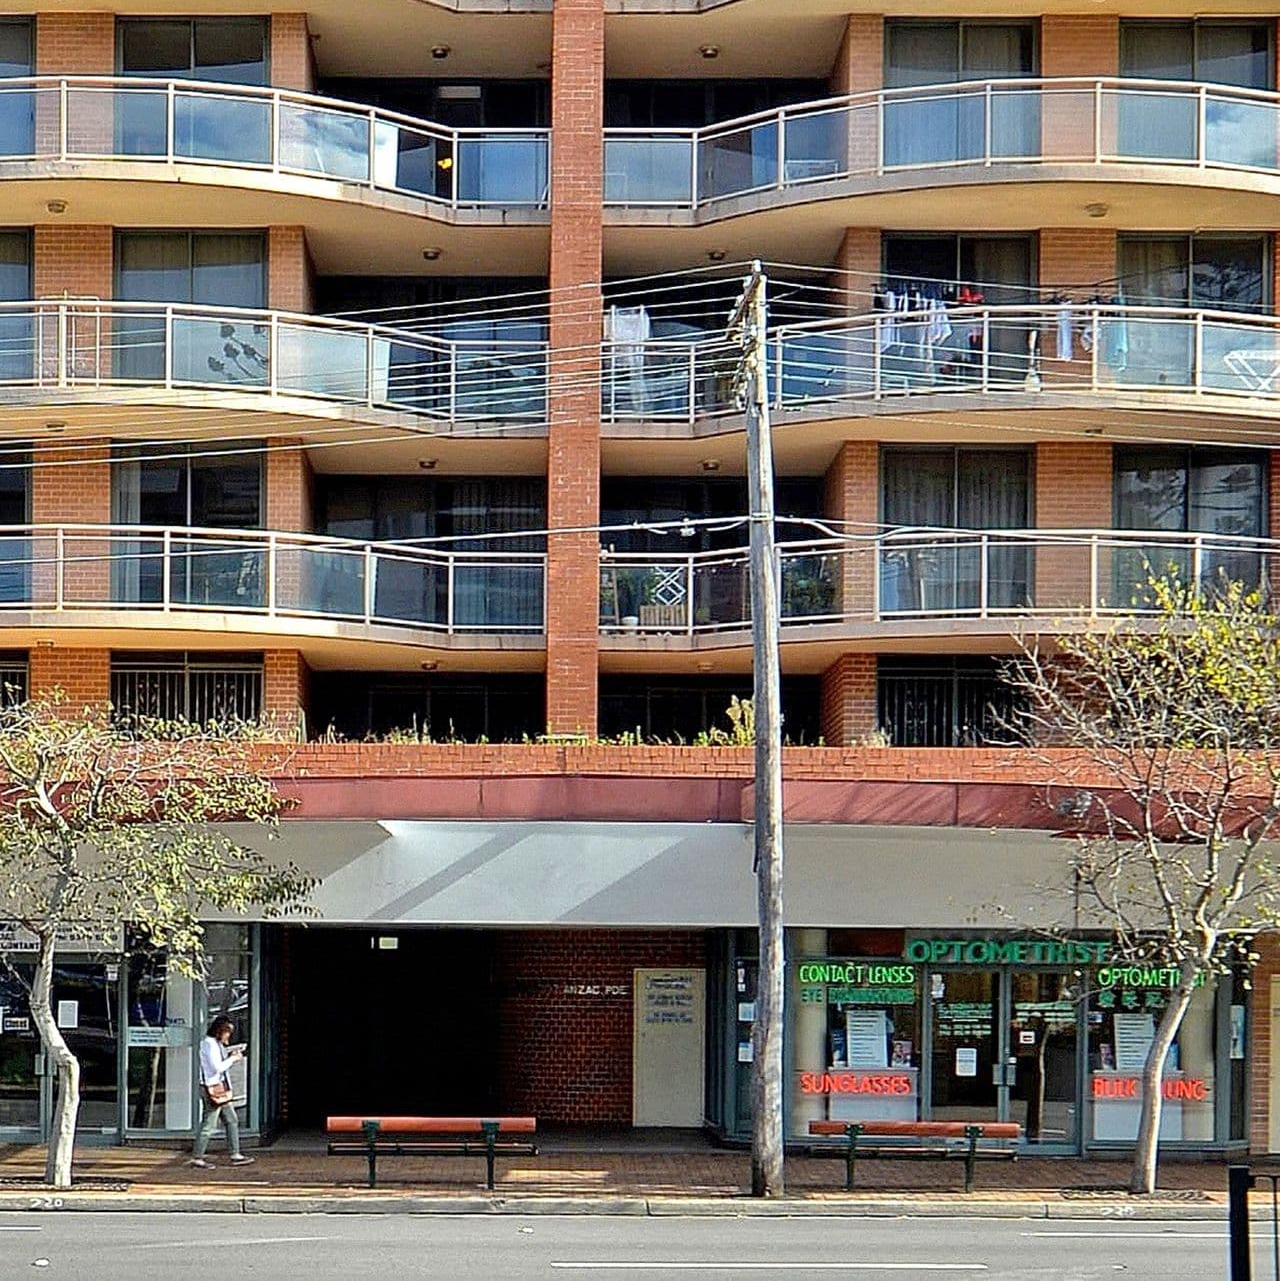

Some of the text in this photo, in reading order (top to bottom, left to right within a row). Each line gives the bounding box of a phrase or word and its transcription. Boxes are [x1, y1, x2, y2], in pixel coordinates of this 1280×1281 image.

[907, 940, 1111, 964] OPTOMETRIST
[800, 964, 915, 984] CONTACT LENSES
[801, 1072, 911, 1095] SUNGLASSES
